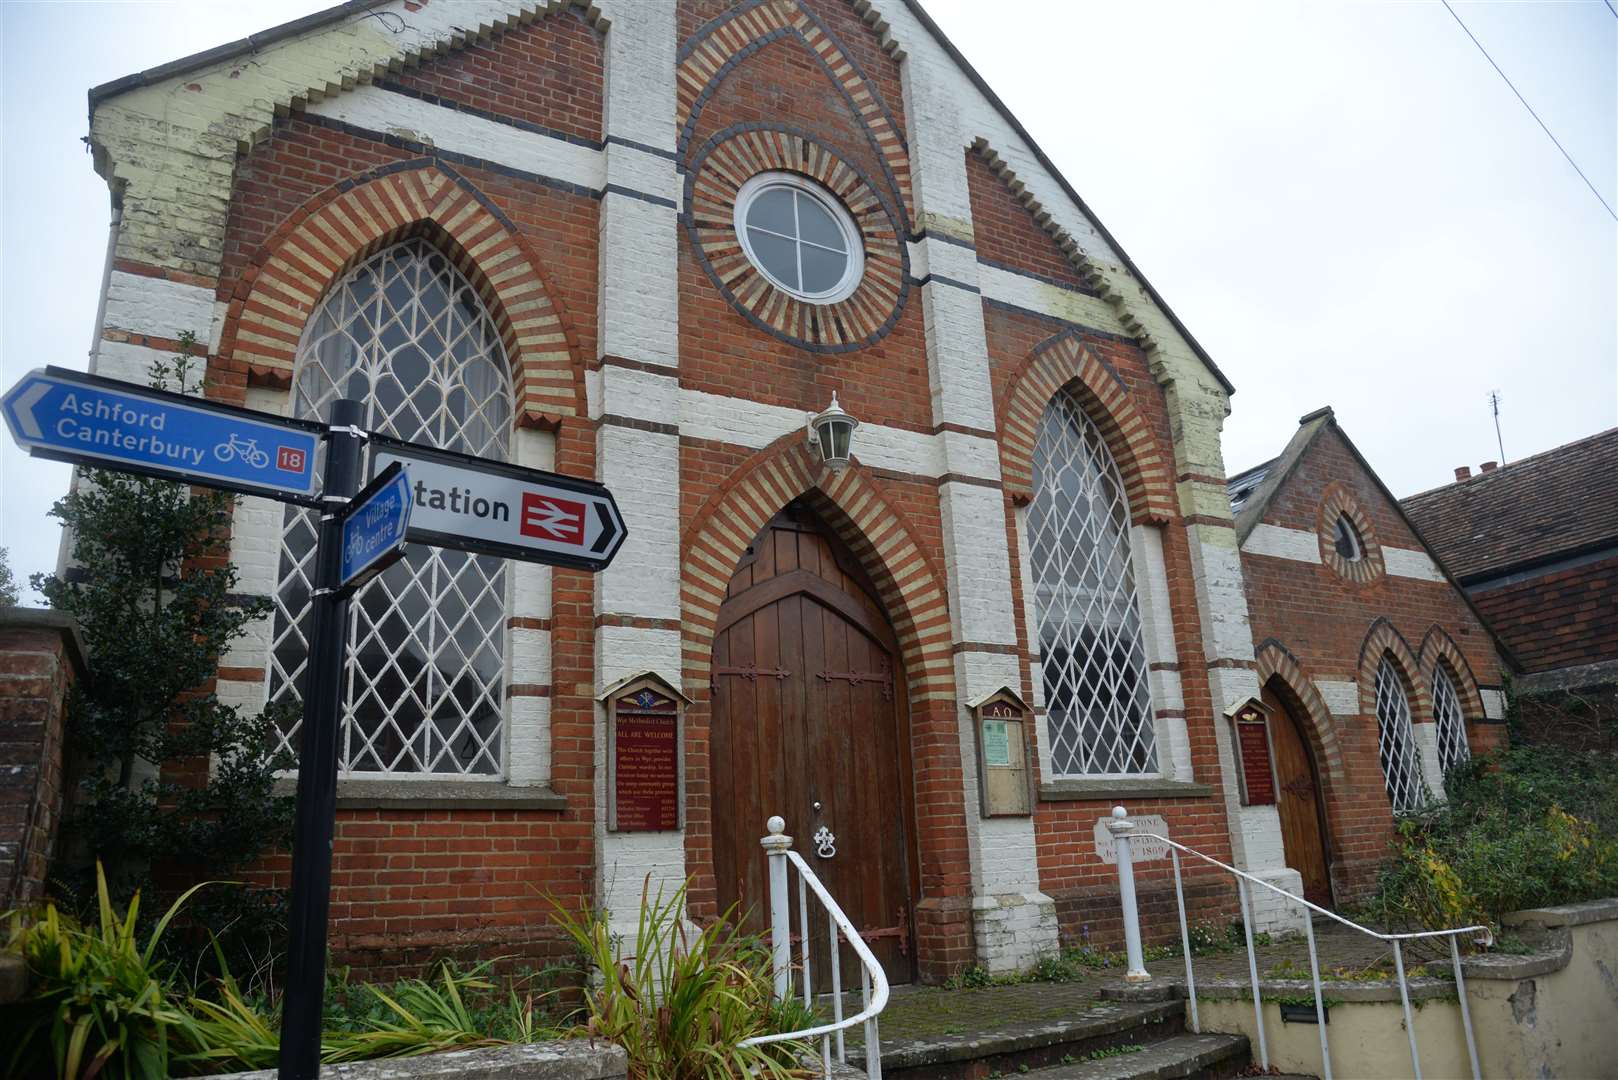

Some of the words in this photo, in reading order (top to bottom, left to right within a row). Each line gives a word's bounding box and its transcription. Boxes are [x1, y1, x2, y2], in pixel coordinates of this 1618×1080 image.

[60, 393, 166, 431] Ashford
[57, 418, 206, 465] Canterbury
[280, 451, 302, 468] 18
[366, 495, 396, 528] Village
[414, 480, 510, 522] tation
[365, 521, 394, 553] centre
